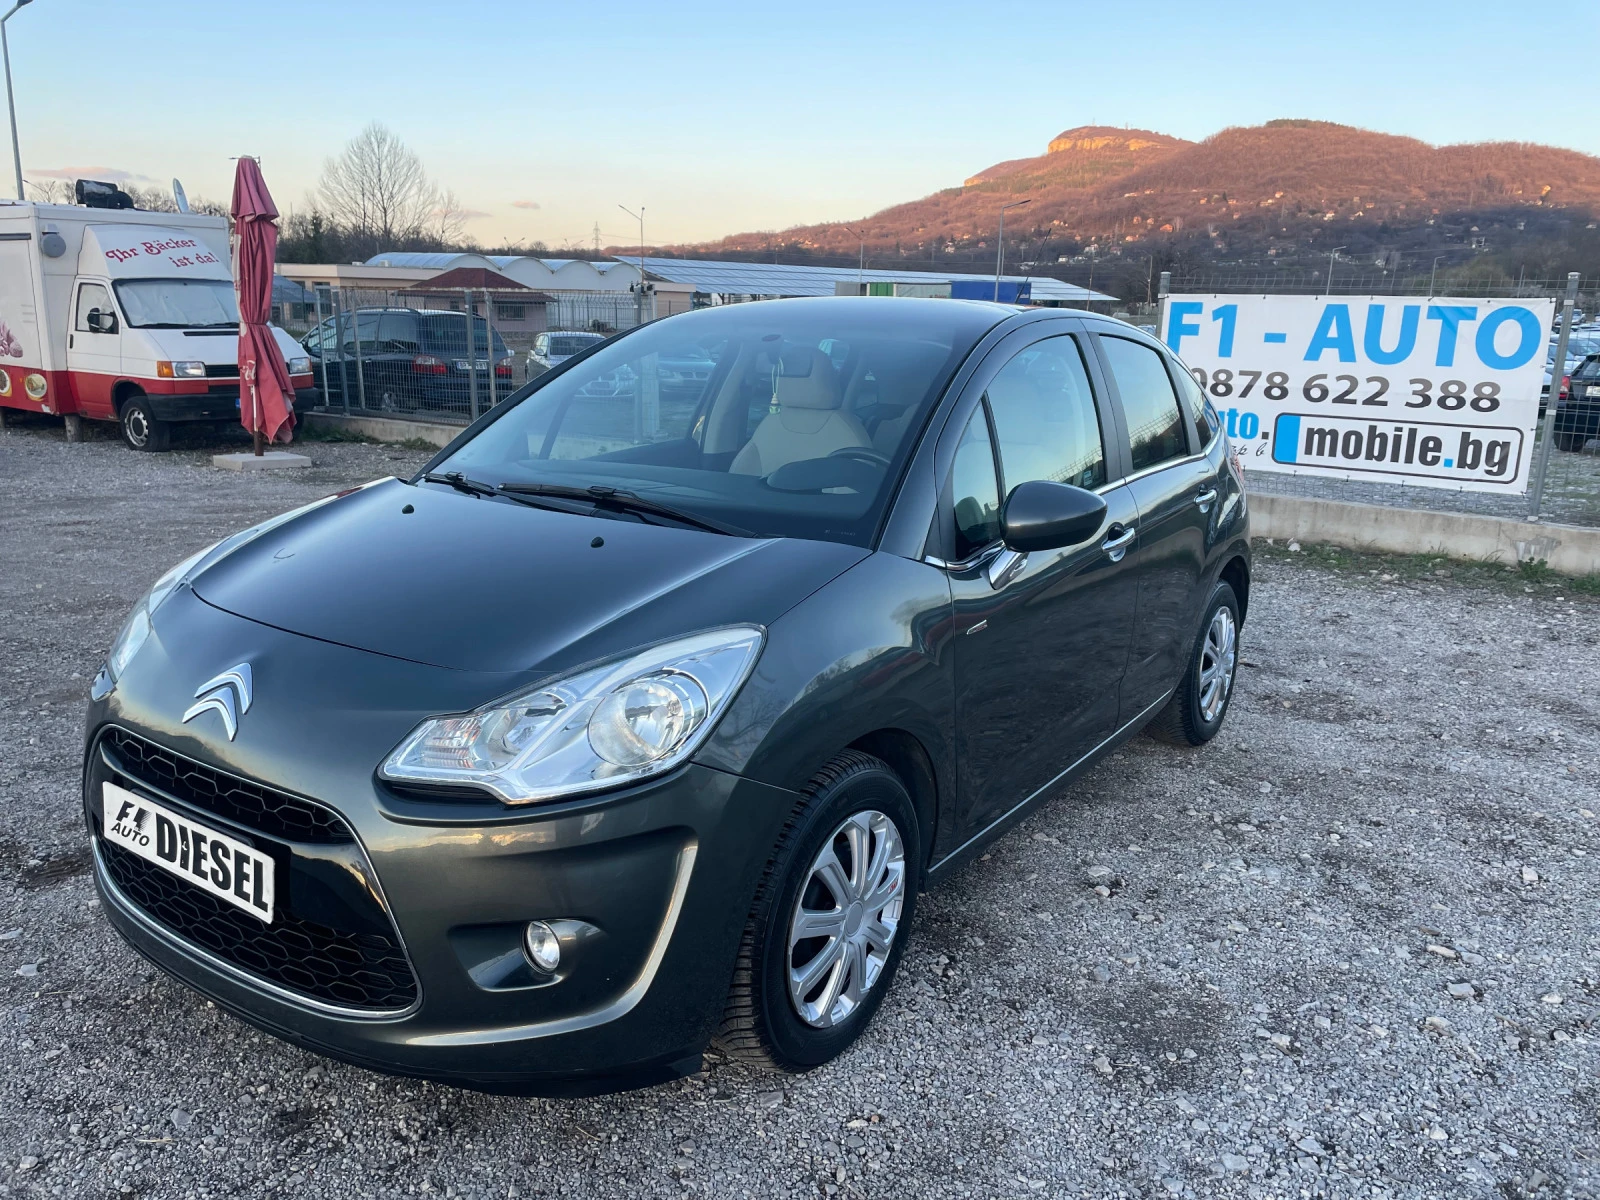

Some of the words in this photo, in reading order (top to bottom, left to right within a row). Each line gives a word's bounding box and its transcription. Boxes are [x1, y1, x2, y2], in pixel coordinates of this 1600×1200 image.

[105, 248, 139, 263] Ihr
[140, 238, 198, 255] Bäcker
[168, 256, 195, 268] ist
[195, 251, 219, 264] da!
[1166, 301, 1238, 358] F1
[1303, 303, 1542, 371] AUTO
[1302, 373, 1390, 407] 622
[1404, 377, 1502, 413] 388
[1304, 424, 1512, 477] mobile.bg
[111, 822, 150, 847] AUTO
[155, 812, 269, 914] DIESEL
